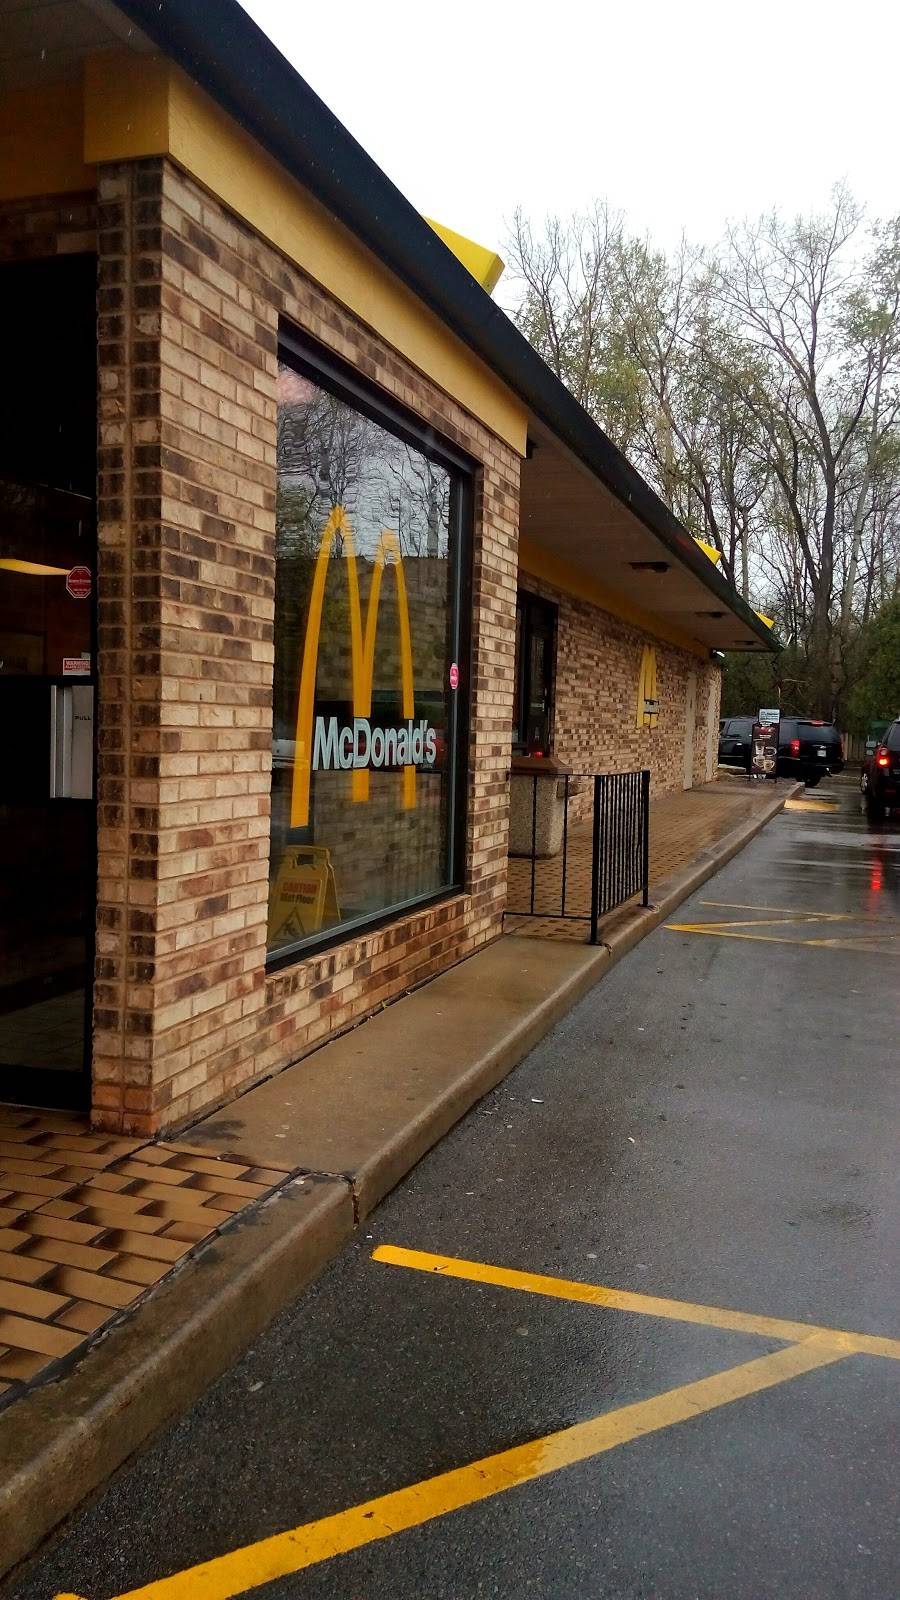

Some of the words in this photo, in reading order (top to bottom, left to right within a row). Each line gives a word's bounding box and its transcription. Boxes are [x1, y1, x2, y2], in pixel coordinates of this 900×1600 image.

[313, 716, 437, 770] McDonald's
[282, 881, 318, 894] CAUTION
[296, 894, 316, 905] Floor
